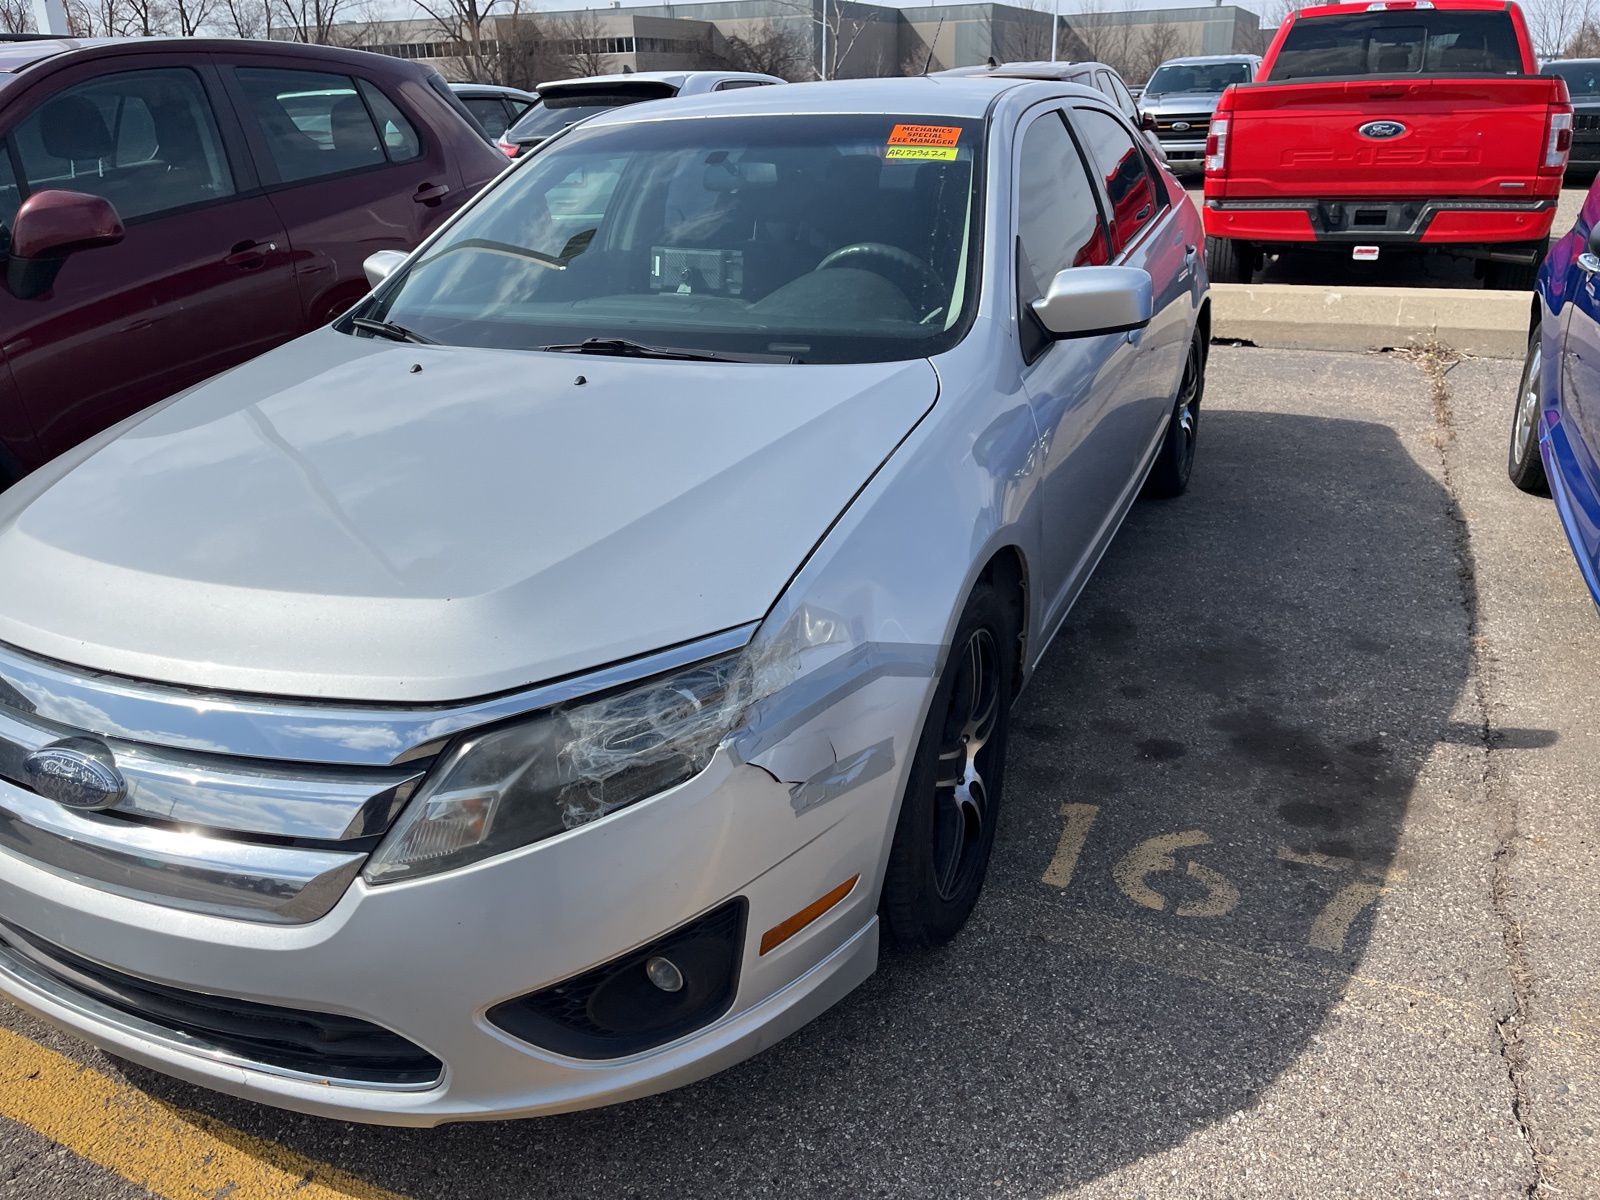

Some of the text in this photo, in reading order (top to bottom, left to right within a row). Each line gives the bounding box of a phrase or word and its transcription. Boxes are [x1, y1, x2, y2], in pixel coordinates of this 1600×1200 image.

[902, 126, 953, 134] MECHANICS
[909, 137, 954, 145] MANAGER
[1280, 146, 1482, 167] F-150
[1040, 802, 1410, 952] 167
